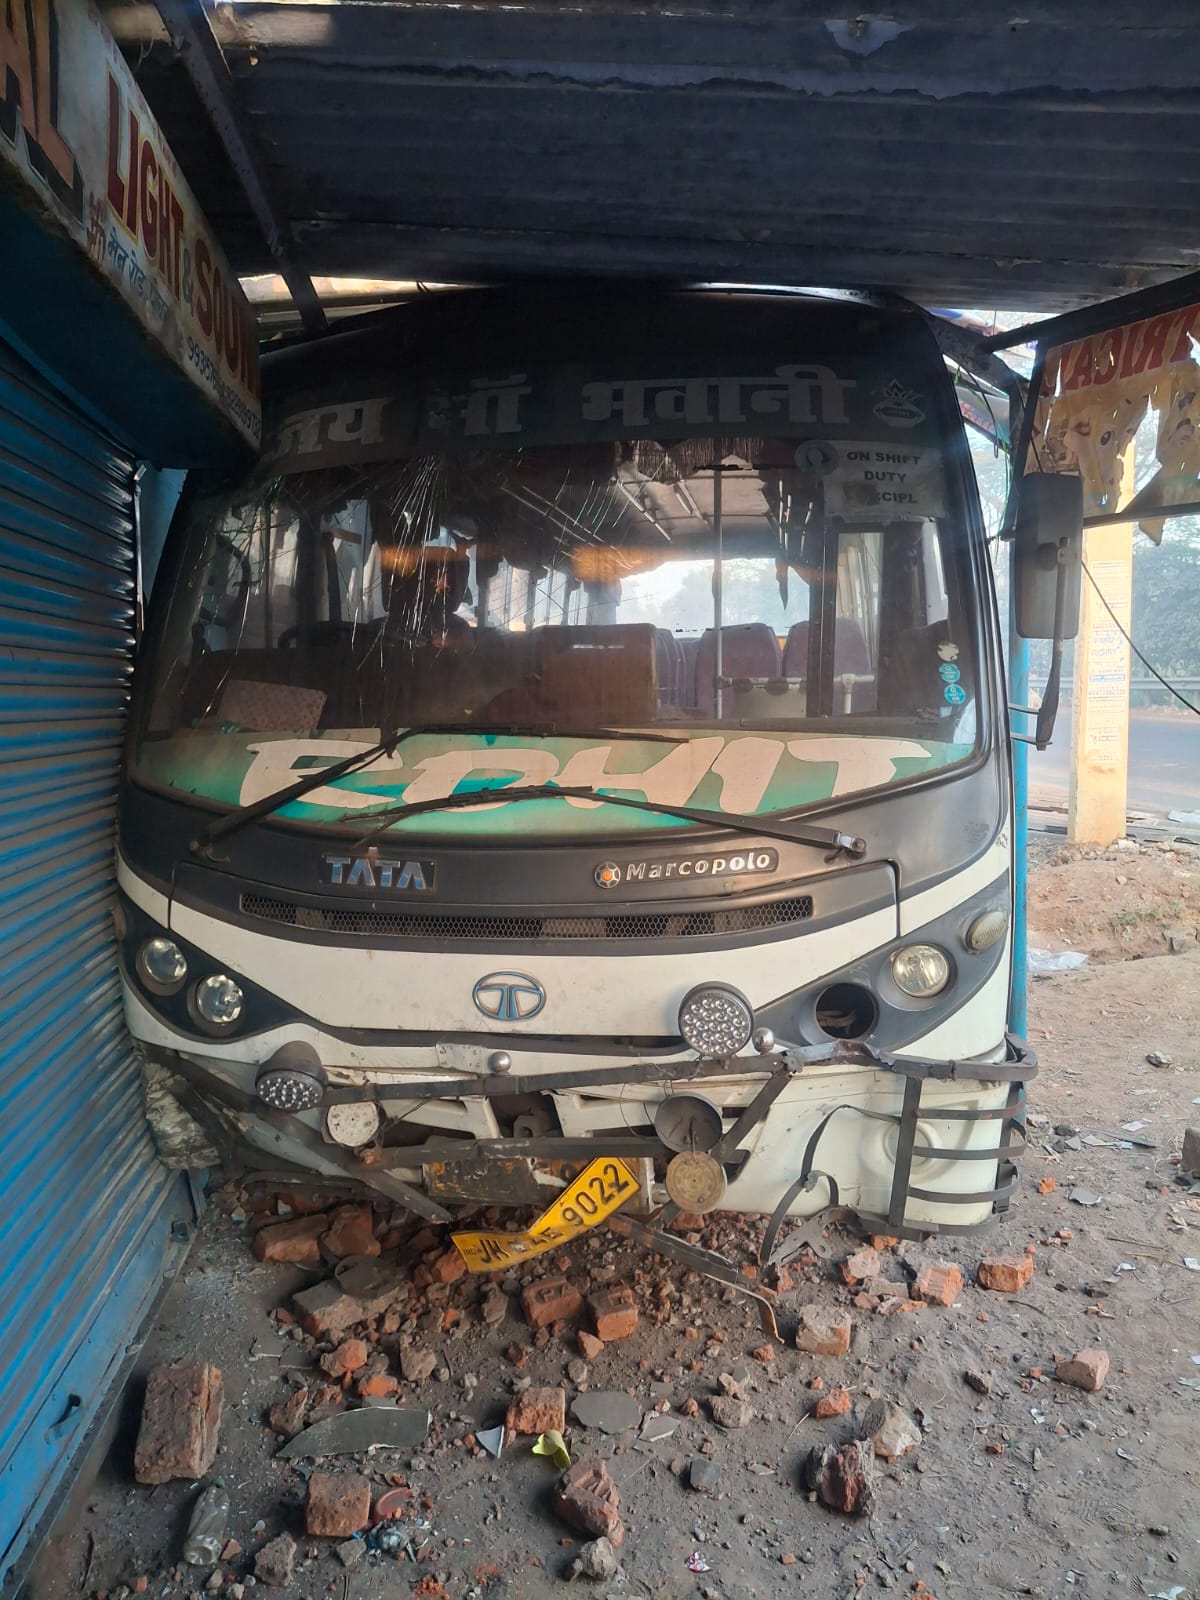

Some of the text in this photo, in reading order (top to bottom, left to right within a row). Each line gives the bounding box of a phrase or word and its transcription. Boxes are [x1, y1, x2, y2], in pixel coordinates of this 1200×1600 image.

[105, 71, 184, 302] LIGHT
[183, 248, 194, 317] &
[581, 363, 857, 428] भवानी
[847, 451, 920, 465] ON SHIFT
[864, 471, 907, 484] DUTY
[325, 855, 427, 890] TATA
[625, 851, 771, 881] Marcopolo
[561, 1163, 631, 1227] 9022
